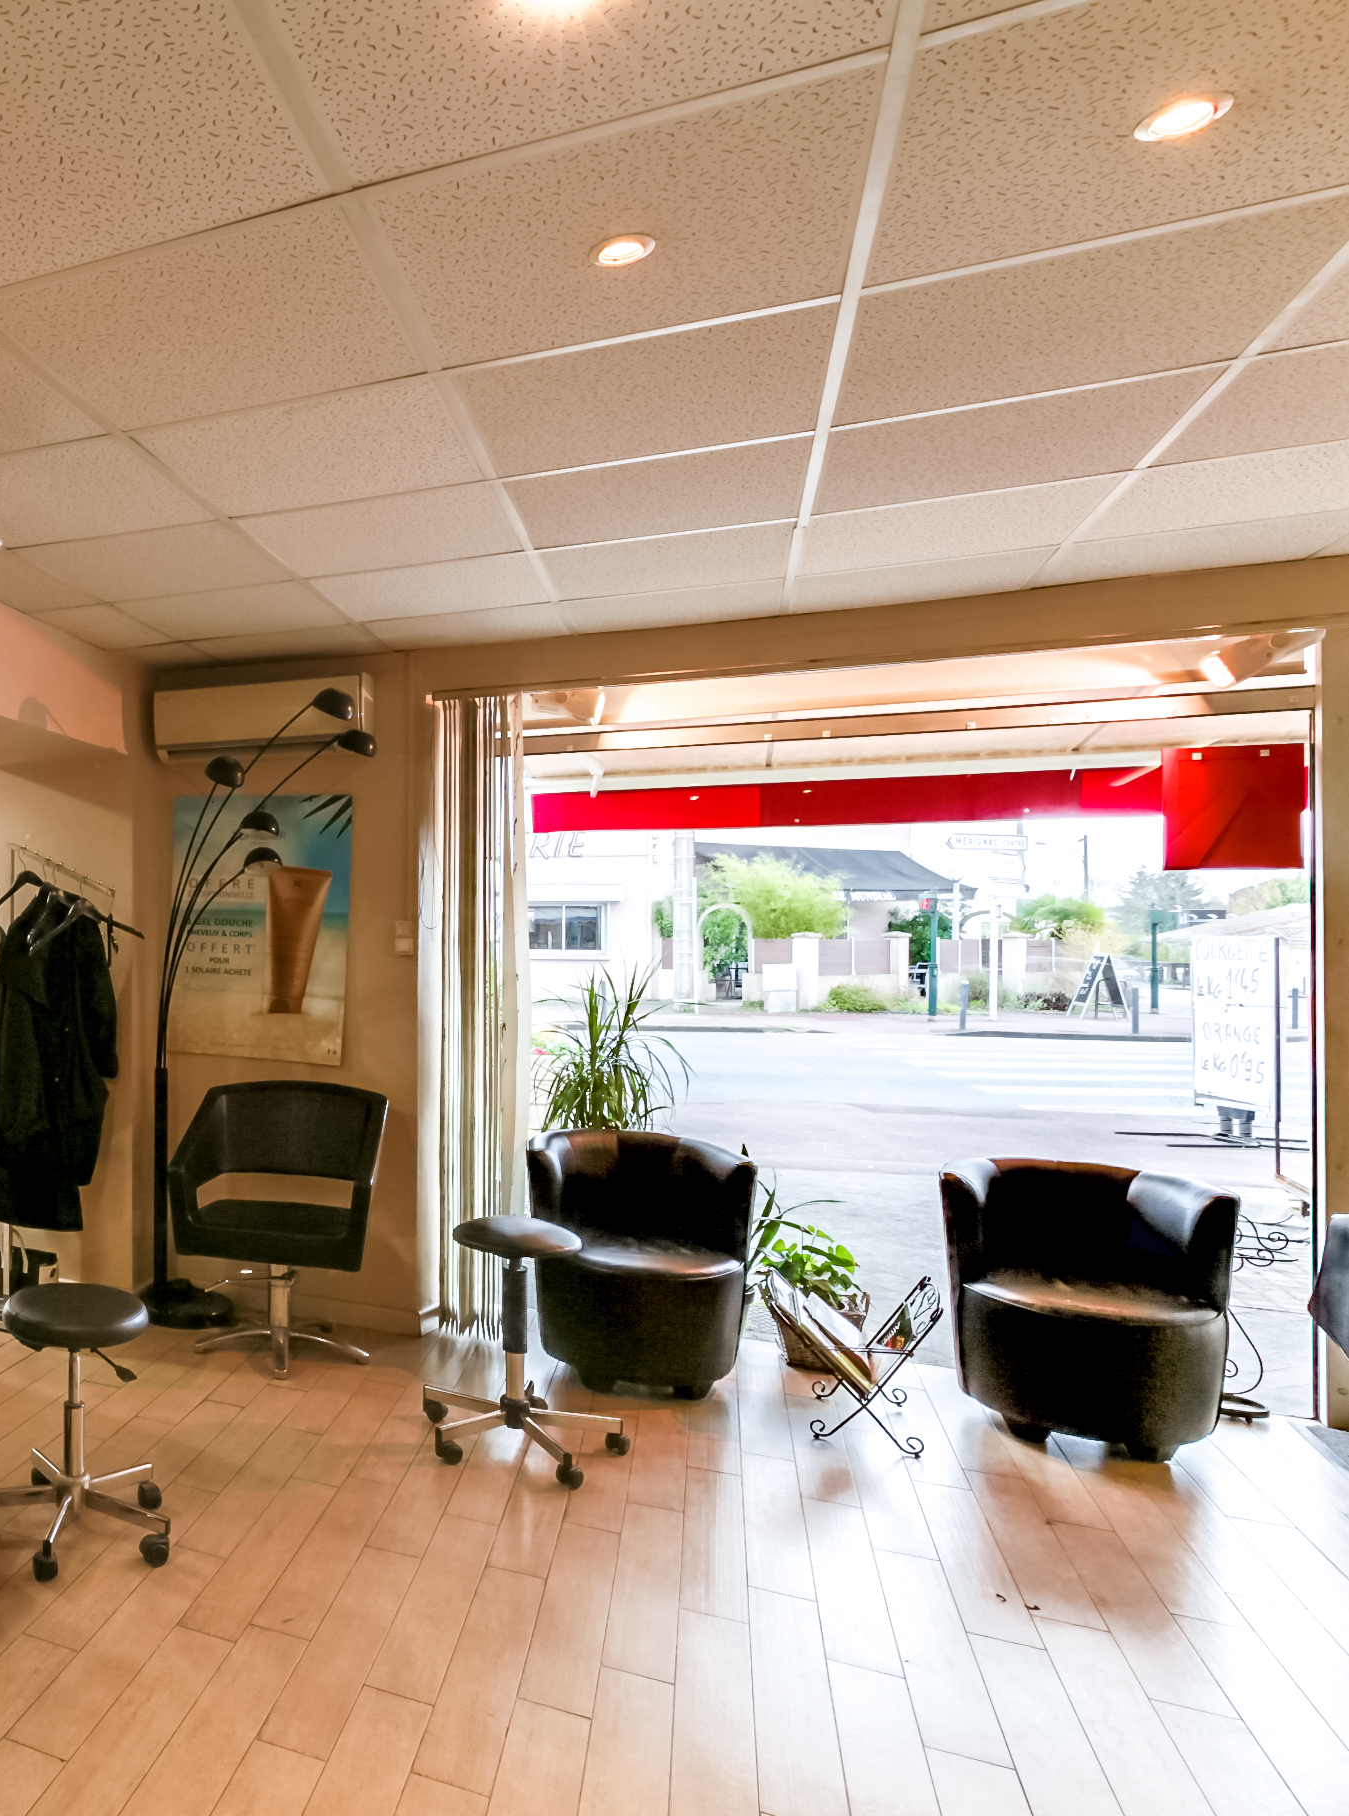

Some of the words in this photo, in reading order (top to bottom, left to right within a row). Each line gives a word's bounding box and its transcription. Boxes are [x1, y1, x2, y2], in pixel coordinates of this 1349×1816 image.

[526, 831, 586, 860] RIE
[955, 837, 998, 847] MÉRIGNAC
[1002, 840, 1025, 848] CENTRE
[188, 878, 255, 890] OFFRE
[188, 890, 255, 899] EEPONNELLE
[195, 917, 212, 926] GEL
[214, 918, 254, 928] DOUCHE
[221, 929, 227, 937] &
[228, 930, 254, 938] CORPS
[1195, 938, 1269, 962] COURGETTE
[208, 956, 230, 964] POUR
[191, 966, 222, 975] SOLAIRE
[223, 967, 252, 977] ACHETÉ
[1202, 1021, 1262, 1045] ORANGE
